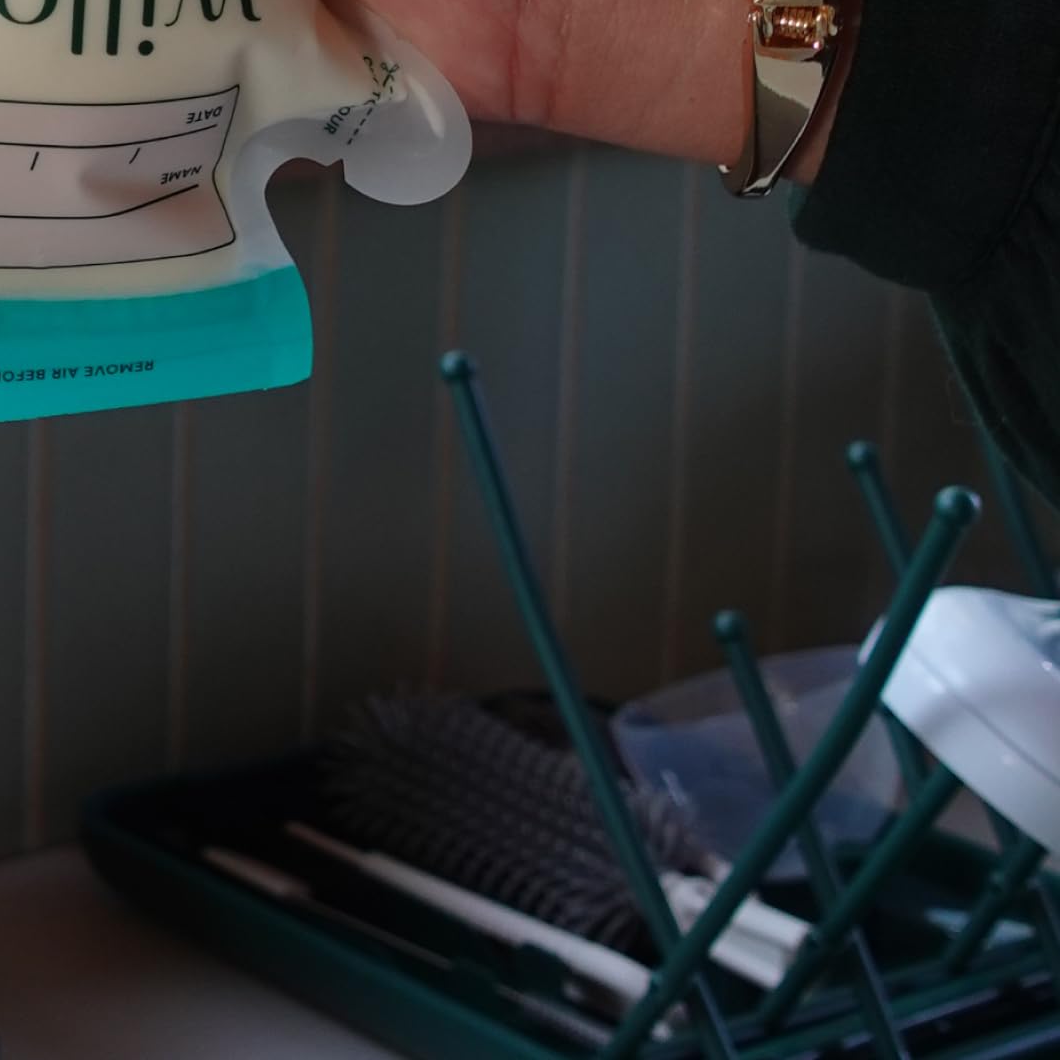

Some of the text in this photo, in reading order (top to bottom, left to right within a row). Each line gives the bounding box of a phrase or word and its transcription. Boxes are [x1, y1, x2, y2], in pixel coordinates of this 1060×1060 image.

[186, 106, 222, 124] DATE
[160, 164, 202, 185] NAME
[51, 366, 79, 380] AIR
[83, 360, 154, 377] REMOVE
